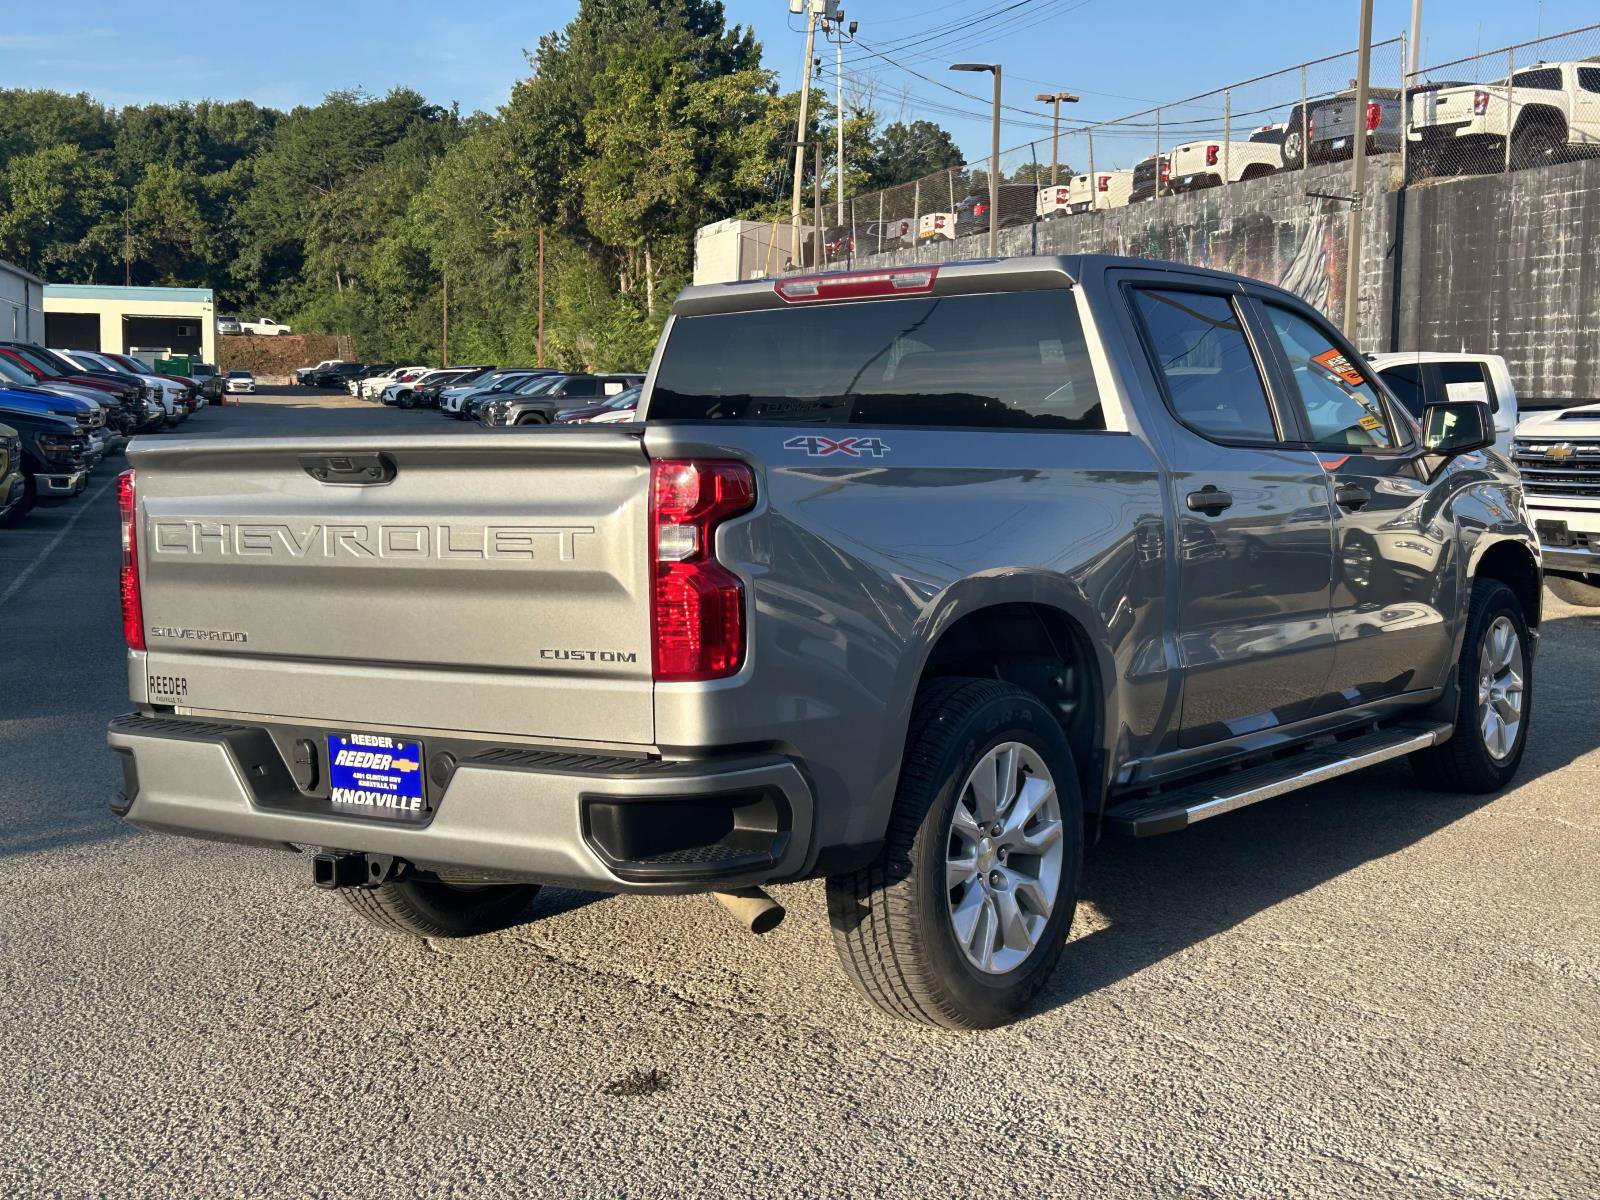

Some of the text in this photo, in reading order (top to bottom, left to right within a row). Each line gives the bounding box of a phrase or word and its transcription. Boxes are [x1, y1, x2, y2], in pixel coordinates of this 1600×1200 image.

[155, 522, 595, 561] CHEVROLET
[151, 627, 248, 642] SILVERADO
[540, 649, 636, 662] CUSTOM
[149, 675, 188, 695] REEDER
[350, 733, 393, 748] REEDER
[335, 750, 393, 770] REEDER
[358, 780, 389, 789] XVILLE,
[331, 787, 422, 811] KNOXVILLE
